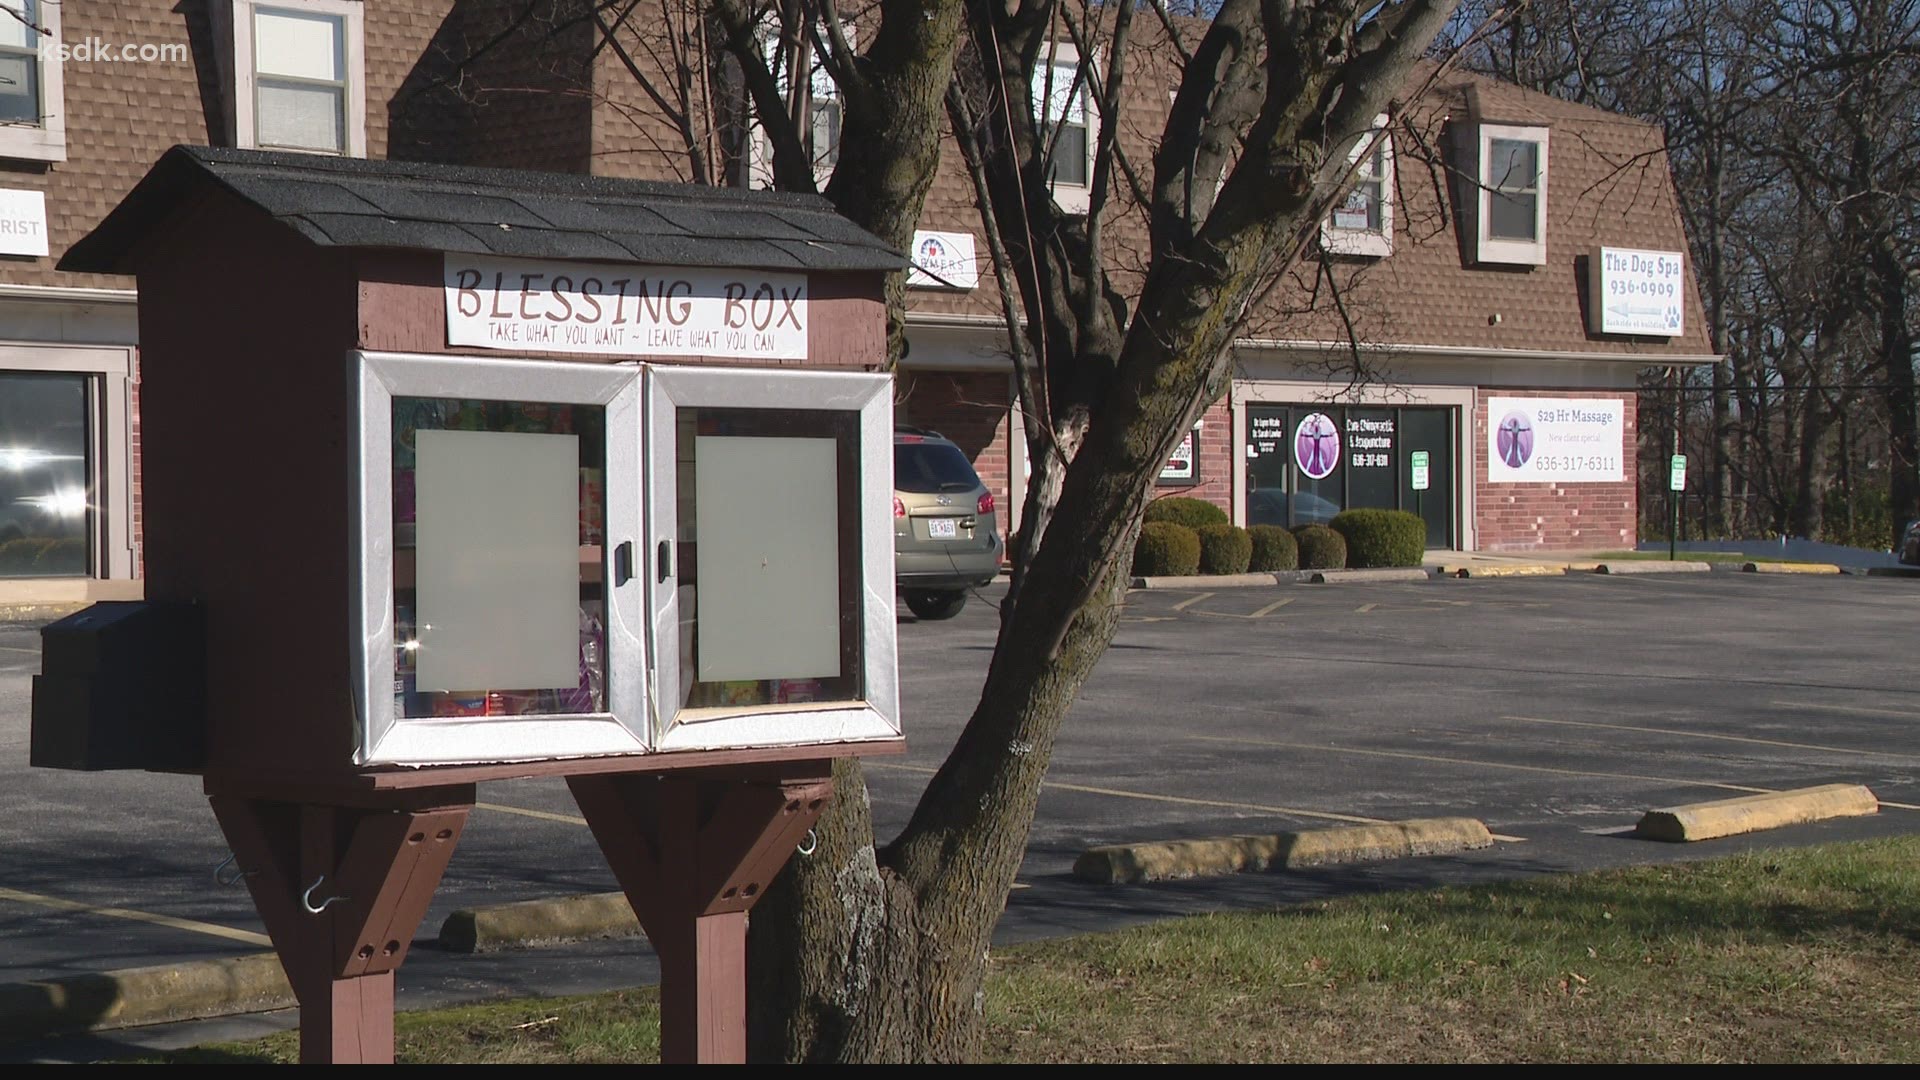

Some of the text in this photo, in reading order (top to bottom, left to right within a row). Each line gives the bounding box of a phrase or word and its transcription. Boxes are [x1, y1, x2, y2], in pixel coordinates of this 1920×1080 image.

[1605, 253, 1679, 278] The Dog Spa
[456, 269, 803, 332] BLESSING BOX
[488, 322, 519, 341] TAKE
[526, 324, 557, 343] WHAT
[565, 326, 588, 344] YOU
[594, 327, 625, 346] WANT
[648, 329, 682, 348] LEAVE
[689, 330, 718, 349] WHAT
[726, 332, 747, 351] YOU
[753, 333, 776, 352] CAN
[1537, 409, 1613, 425] $29 Hr Massage
[1360, 418, 1394, 434] Chiropractic
[1355, 435, 1391, 450] Acupuncture
[1548, 433, 1601, 444] New client special
[1536, 456, 1615, 471] 636-317-6311
